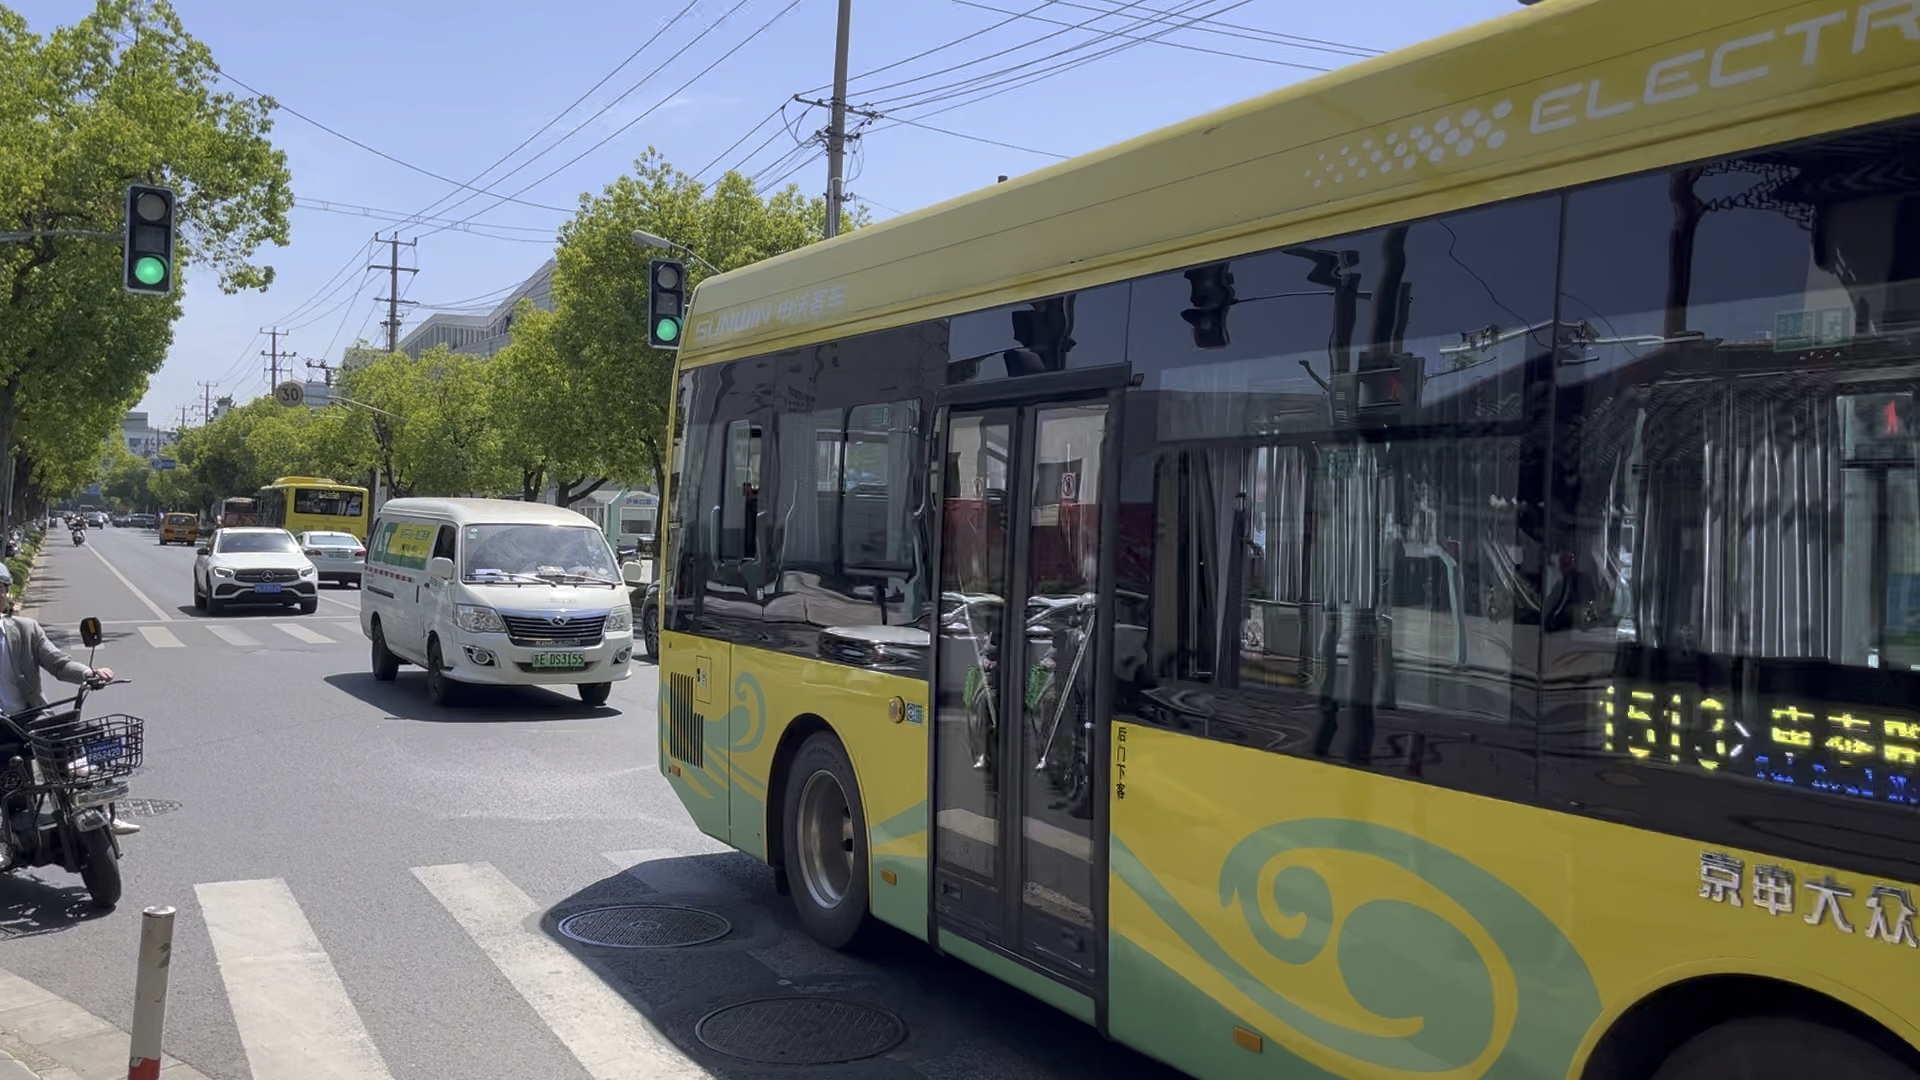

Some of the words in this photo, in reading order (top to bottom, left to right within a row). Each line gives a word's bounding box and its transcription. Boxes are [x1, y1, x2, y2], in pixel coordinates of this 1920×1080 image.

[1529, 0, 1920, 134] ELECTR
[694, 303, 771, 341] SUNWIN
[282, 388, 300, 401] 30
[550, 654, 584, 665] DS3155
